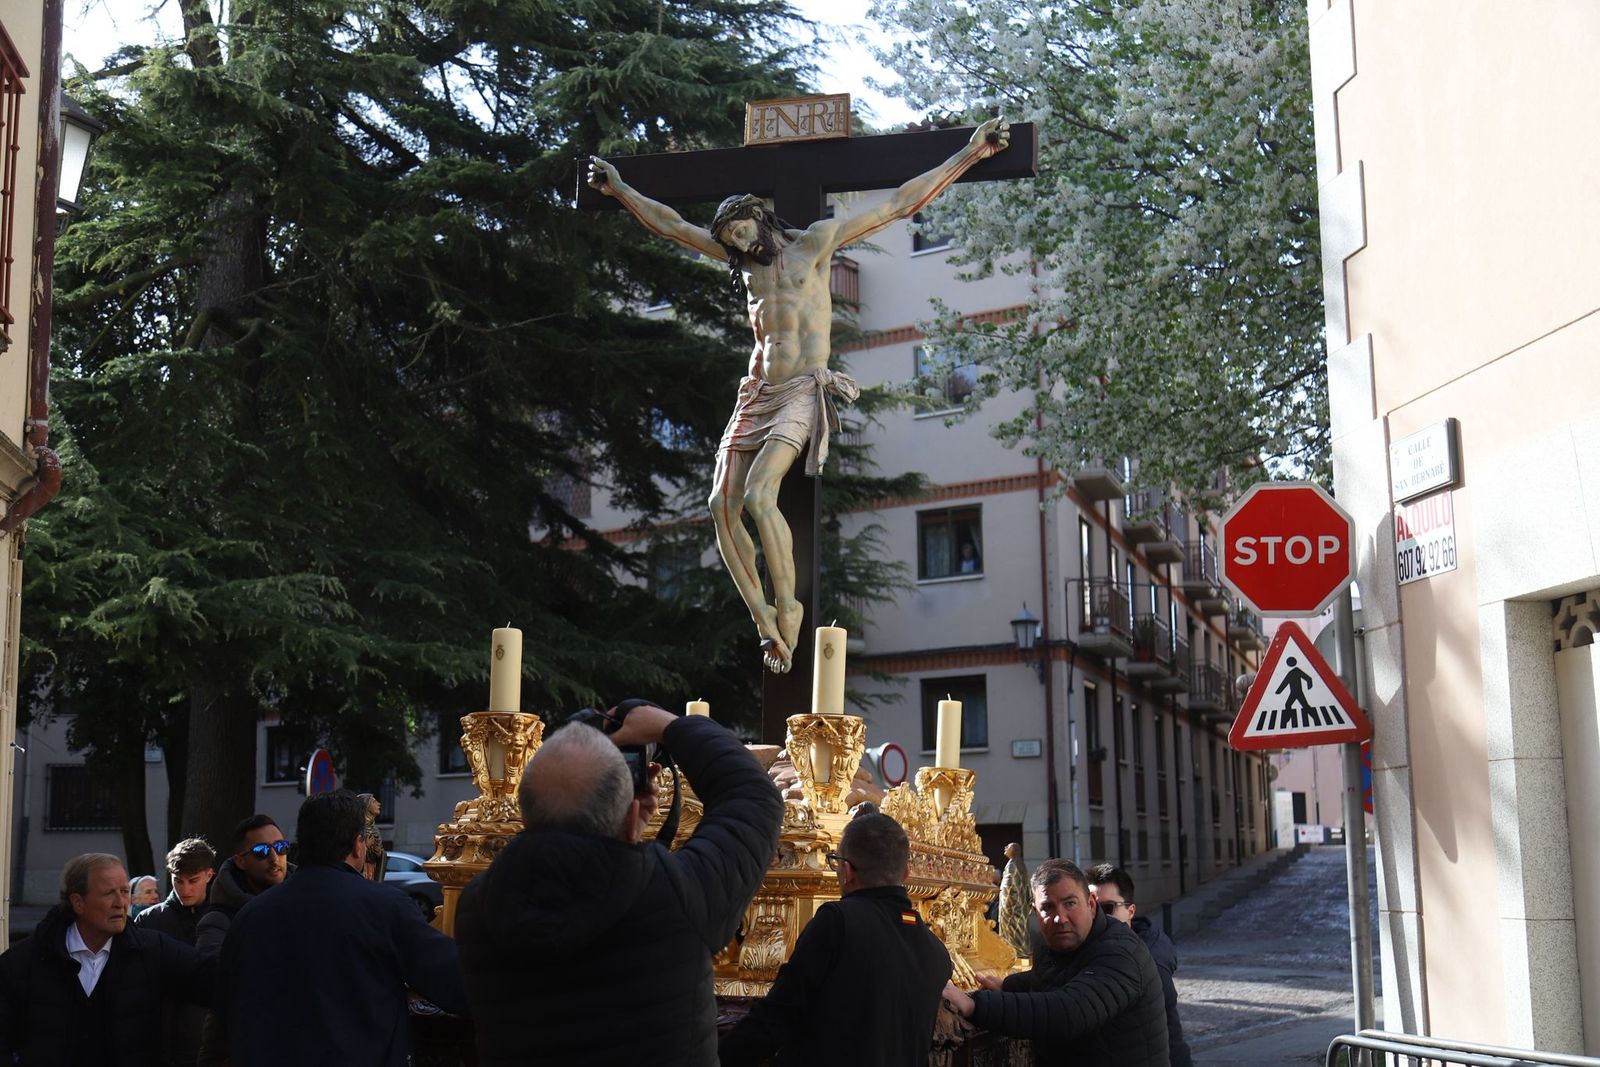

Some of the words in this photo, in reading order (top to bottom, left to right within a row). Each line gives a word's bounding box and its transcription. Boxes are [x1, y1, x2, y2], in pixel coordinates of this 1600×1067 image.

[757, 101, 843, 139] INRI
[1408, 437, 1432, 455] CALLE
[1413, 456, 1424, 469] DE
[1395, 480, 1409, 493] SAN
[1396, 490, 1451, 542] ALQUILO
[1233, 535, 1340, 566] STOP
[1398, 548, 1413, 582] 607
[1415, 545, 1428, 576] 92
[1428, 540, 1441, 572] 92
[1442, 535, 1455, 567] 66
